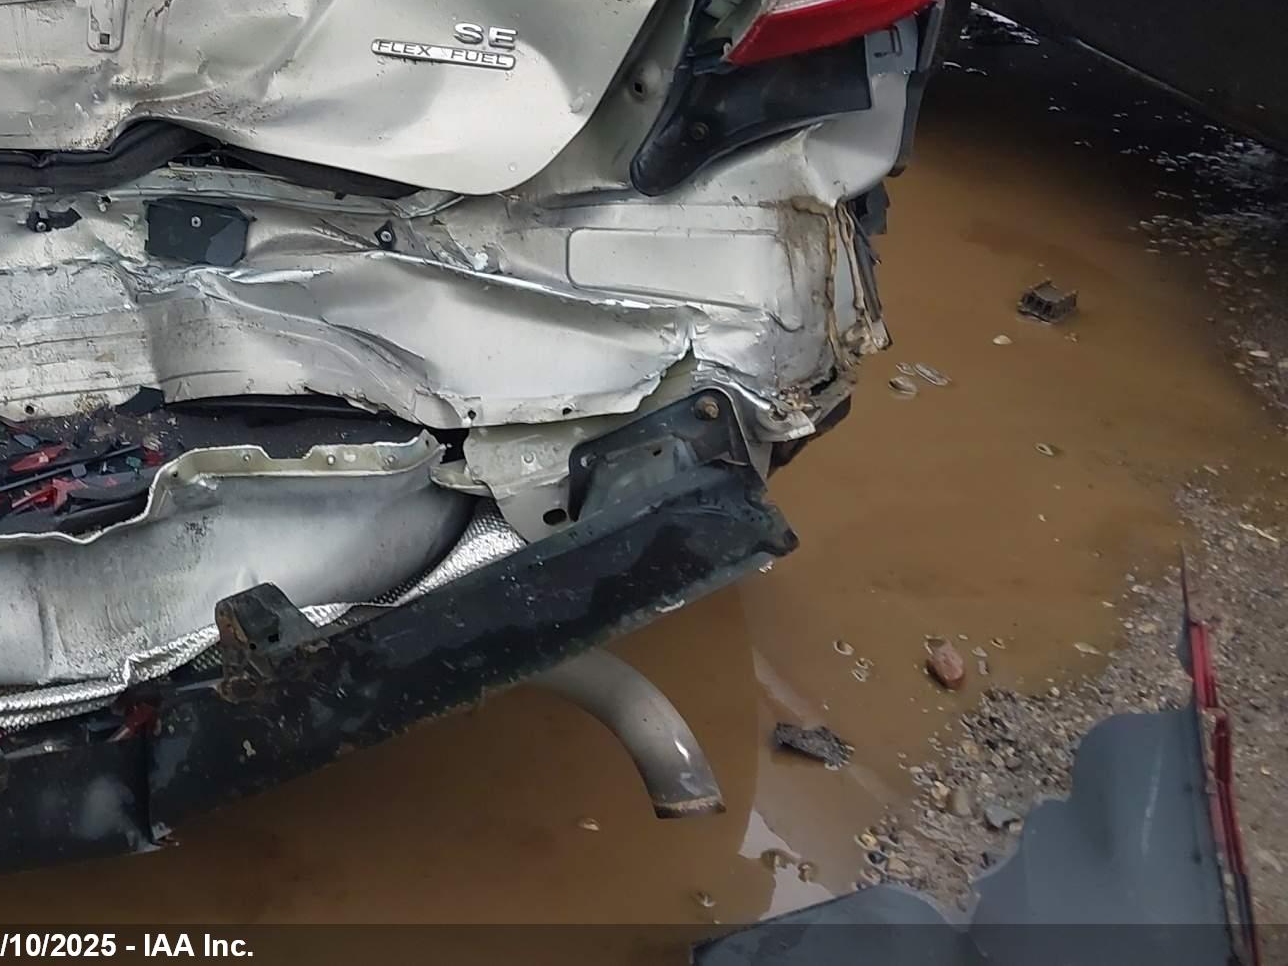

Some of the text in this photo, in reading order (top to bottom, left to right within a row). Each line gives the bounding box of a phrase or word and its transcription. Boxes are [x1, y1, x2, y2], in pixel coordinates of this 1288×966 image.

[454, 22, 517, 49] SE
[377, 41, 507, 66] FLEX FUEL
